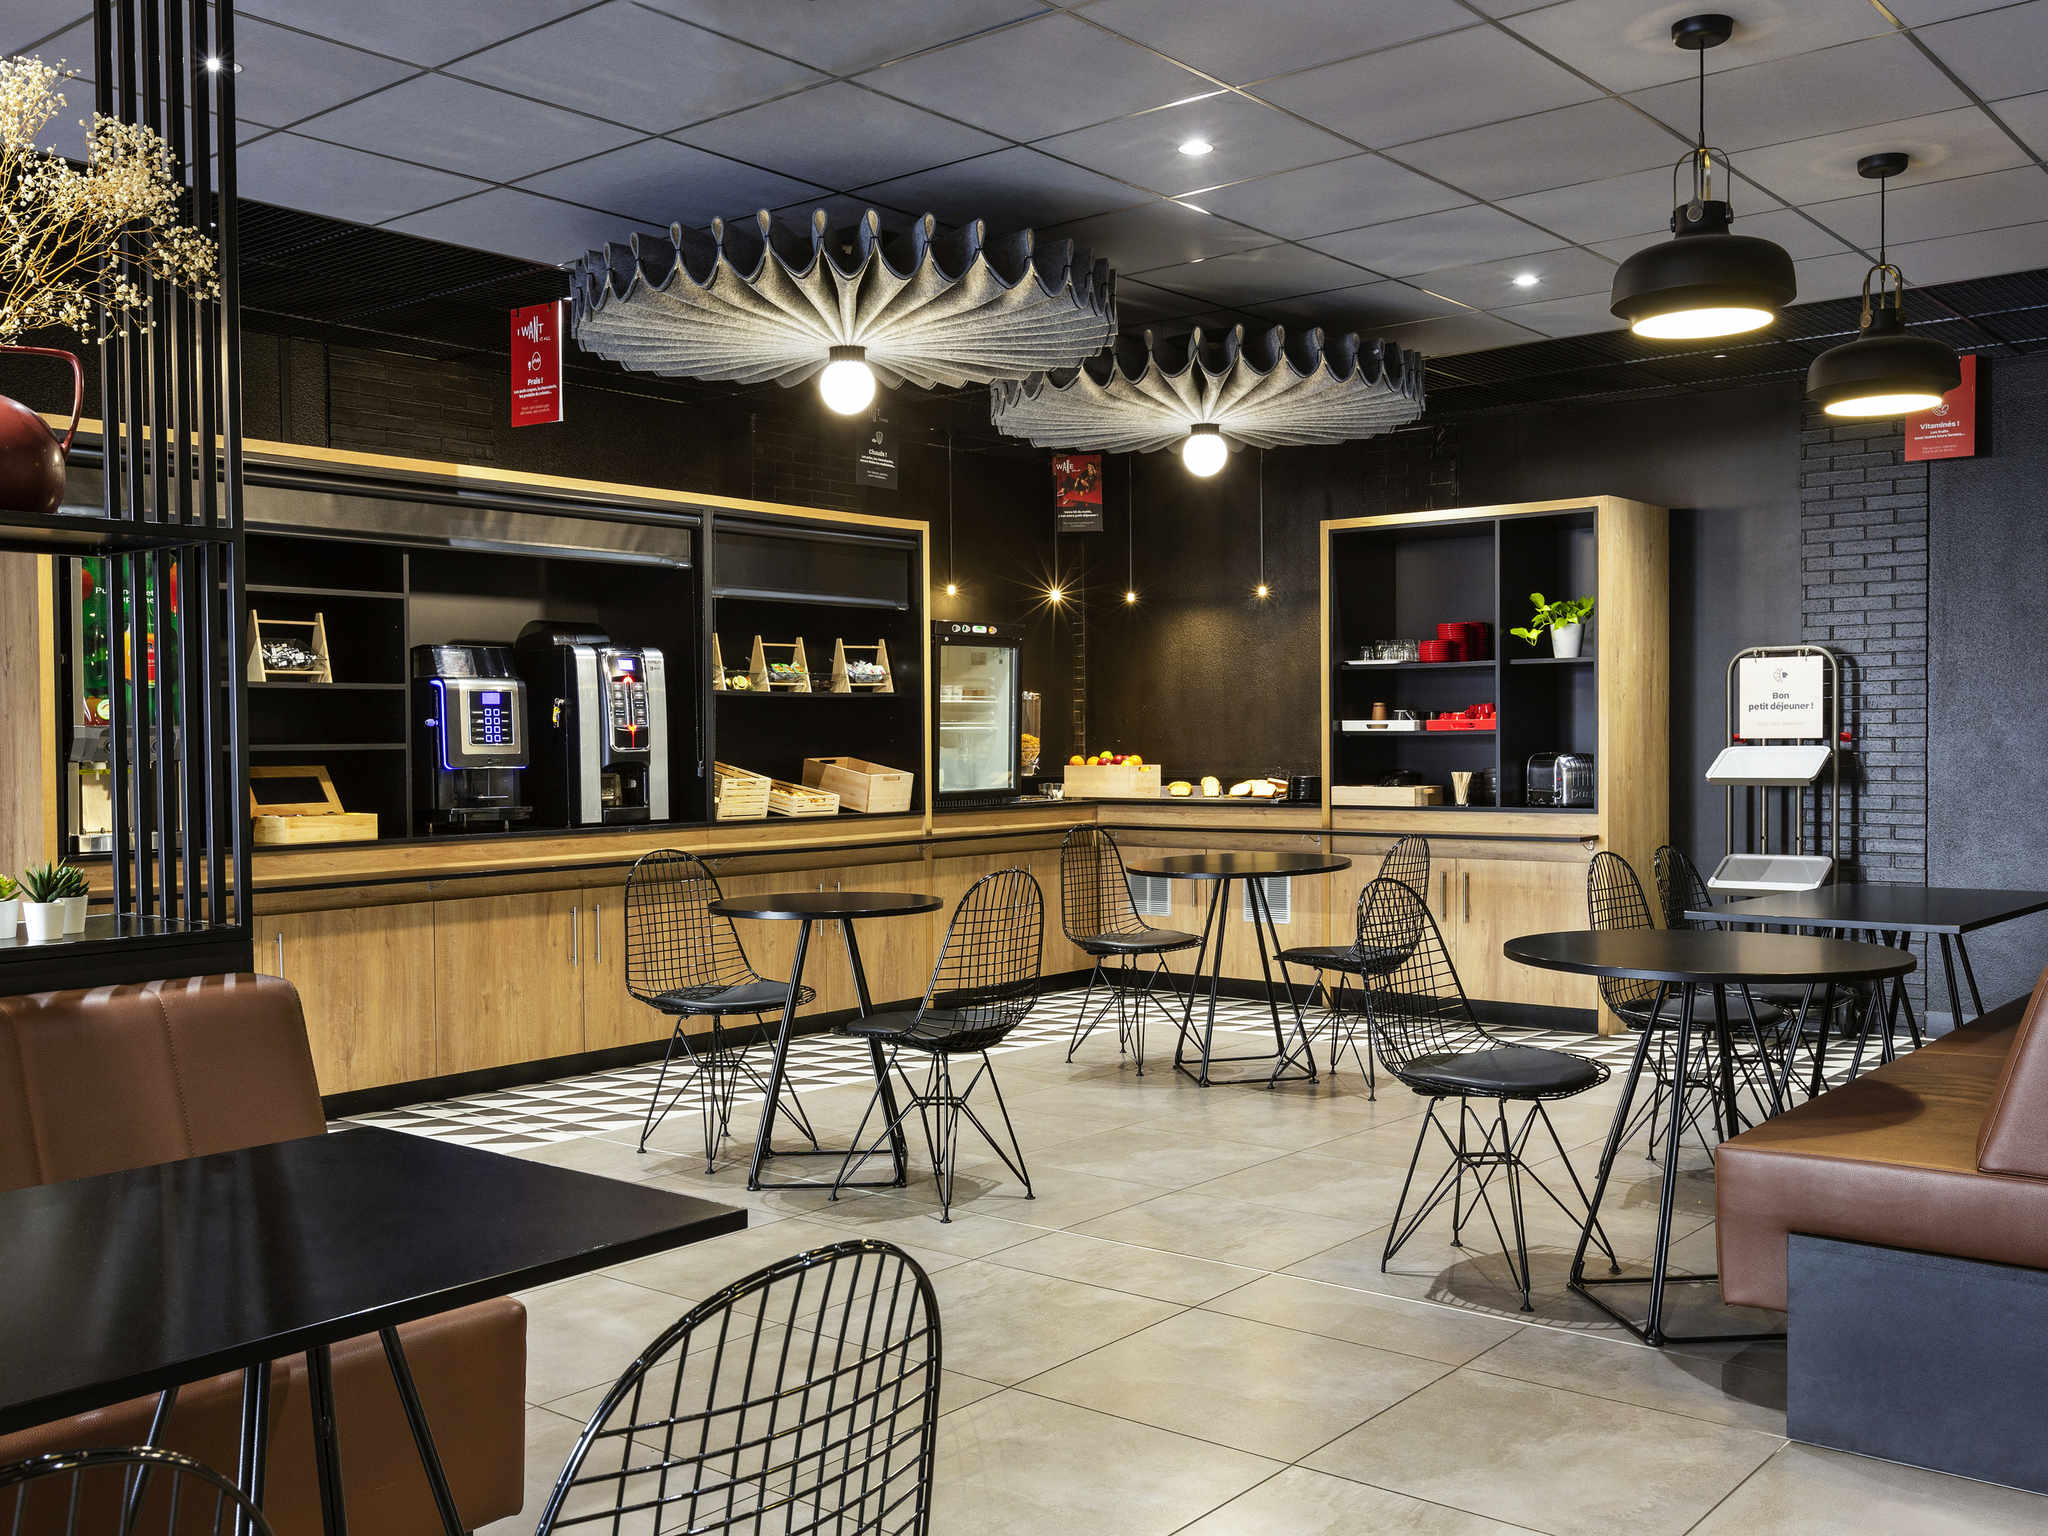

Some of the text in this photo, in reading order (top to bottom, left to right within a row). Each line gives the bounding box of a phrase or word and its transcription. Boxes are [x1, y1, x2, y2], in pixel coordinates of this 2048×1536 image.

[1772, 692, 1790, 700] Bon
[1748, 702, 1769, 712] petit
[1770, 701, 1810, 712] déjeuner
